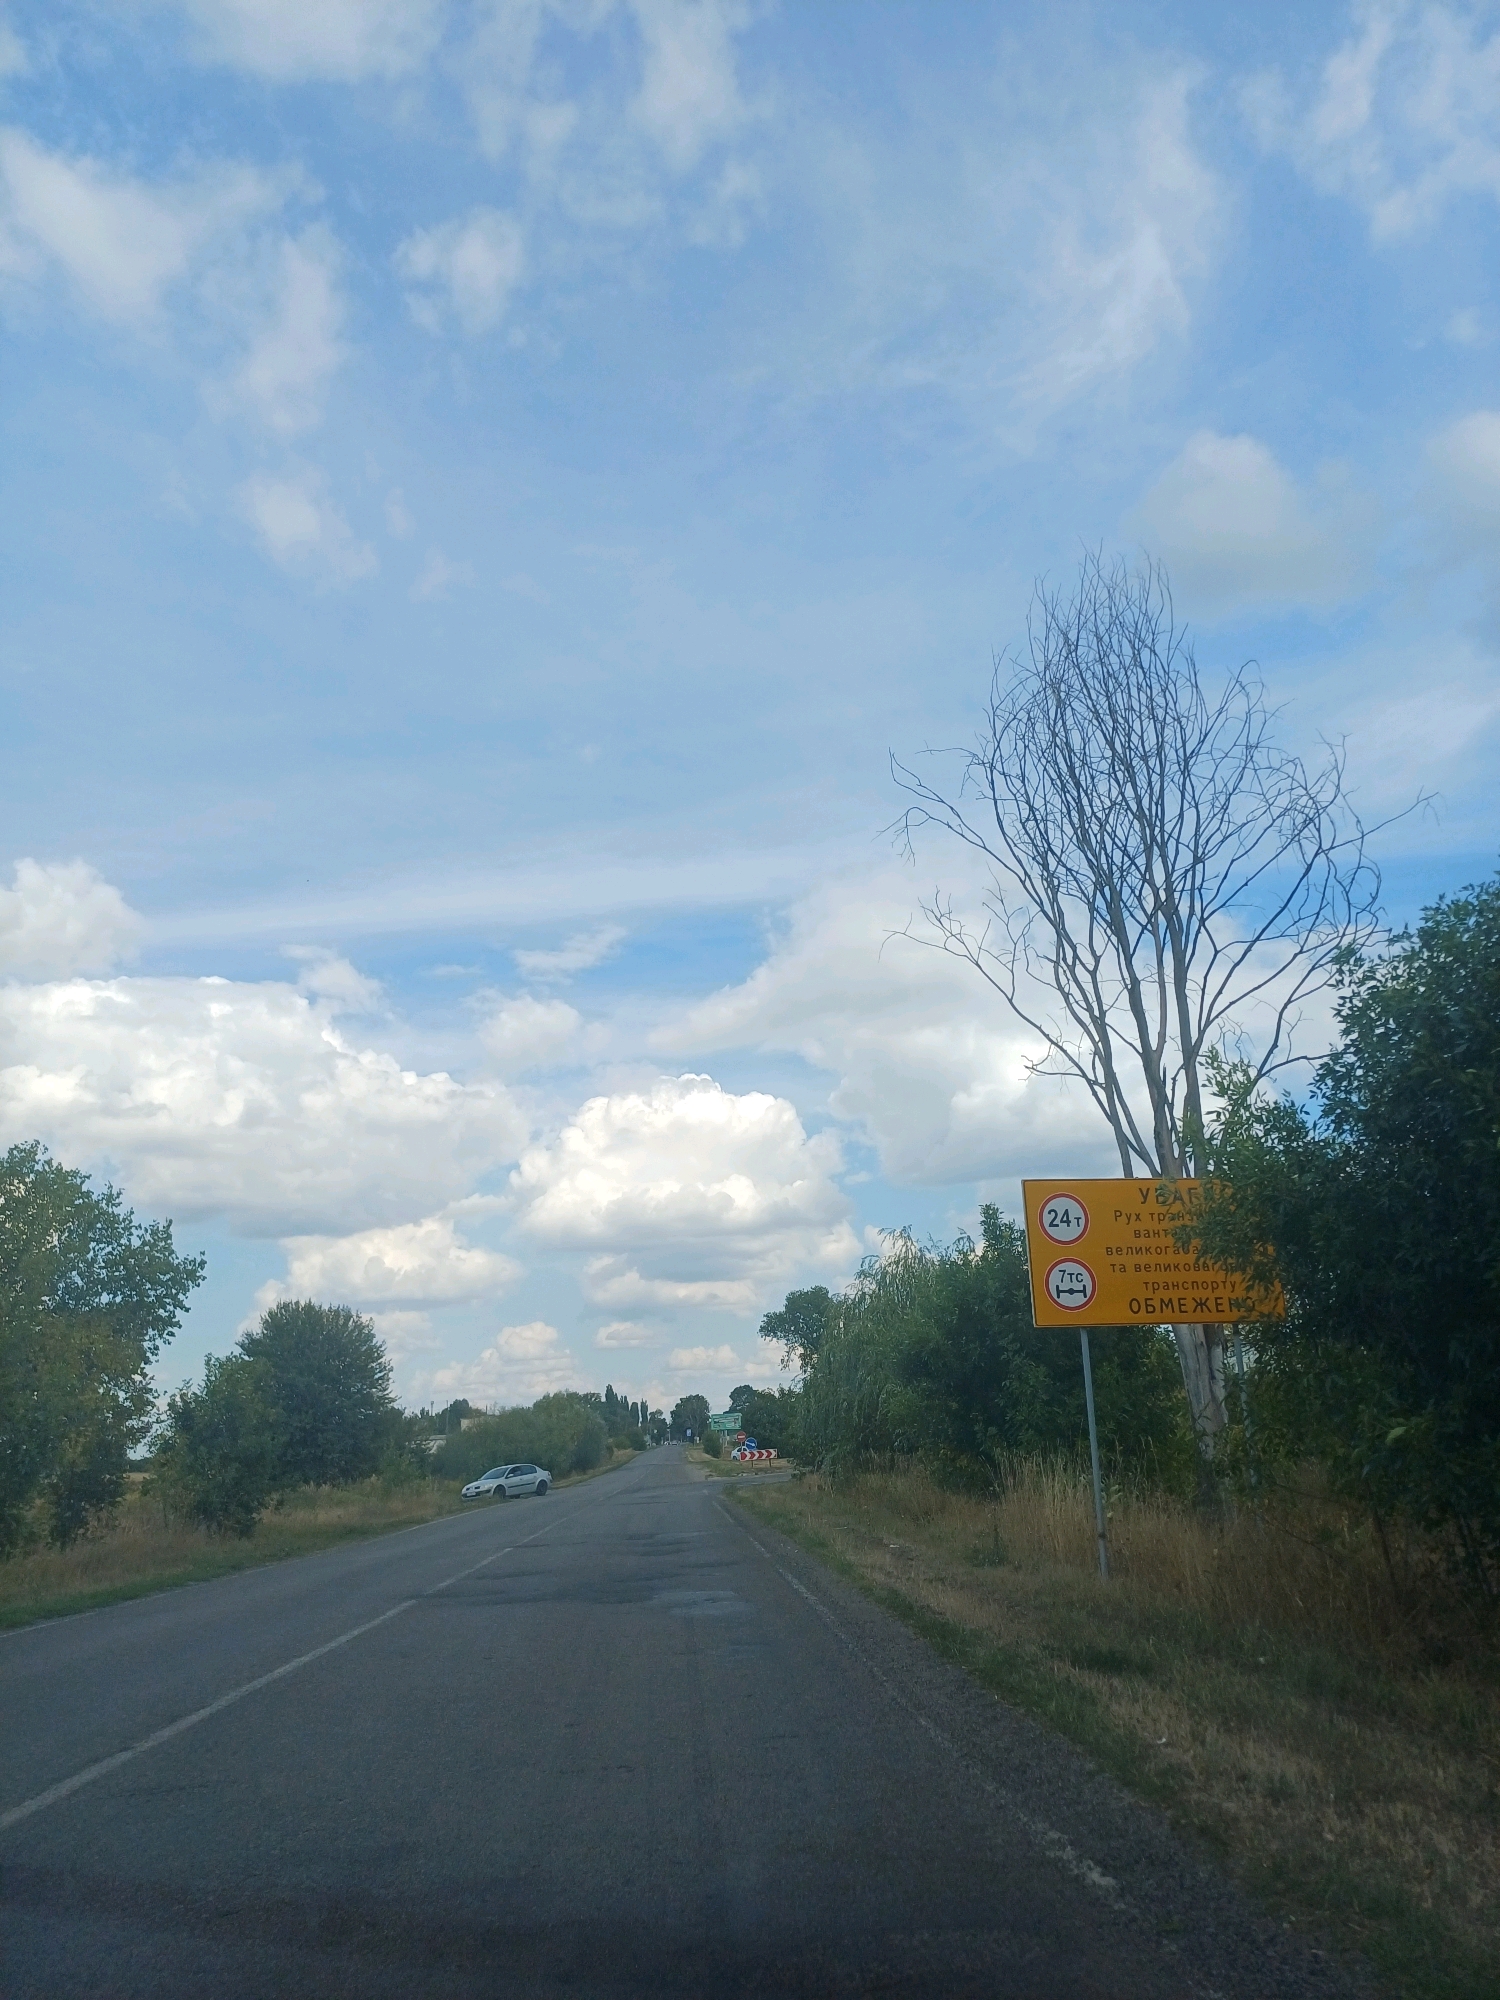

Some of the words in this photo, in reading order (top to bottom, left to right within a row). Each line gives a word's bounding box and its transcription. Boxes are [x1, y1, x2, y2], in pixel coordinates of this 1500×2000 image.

[1114, 1210, 1142, 1226] Рух
[1105, 1244, 1200, 1256] великогаба
[1110, 1262, 1127, 1273] та
[1143, 1279, 1237, 1294] транспорту
